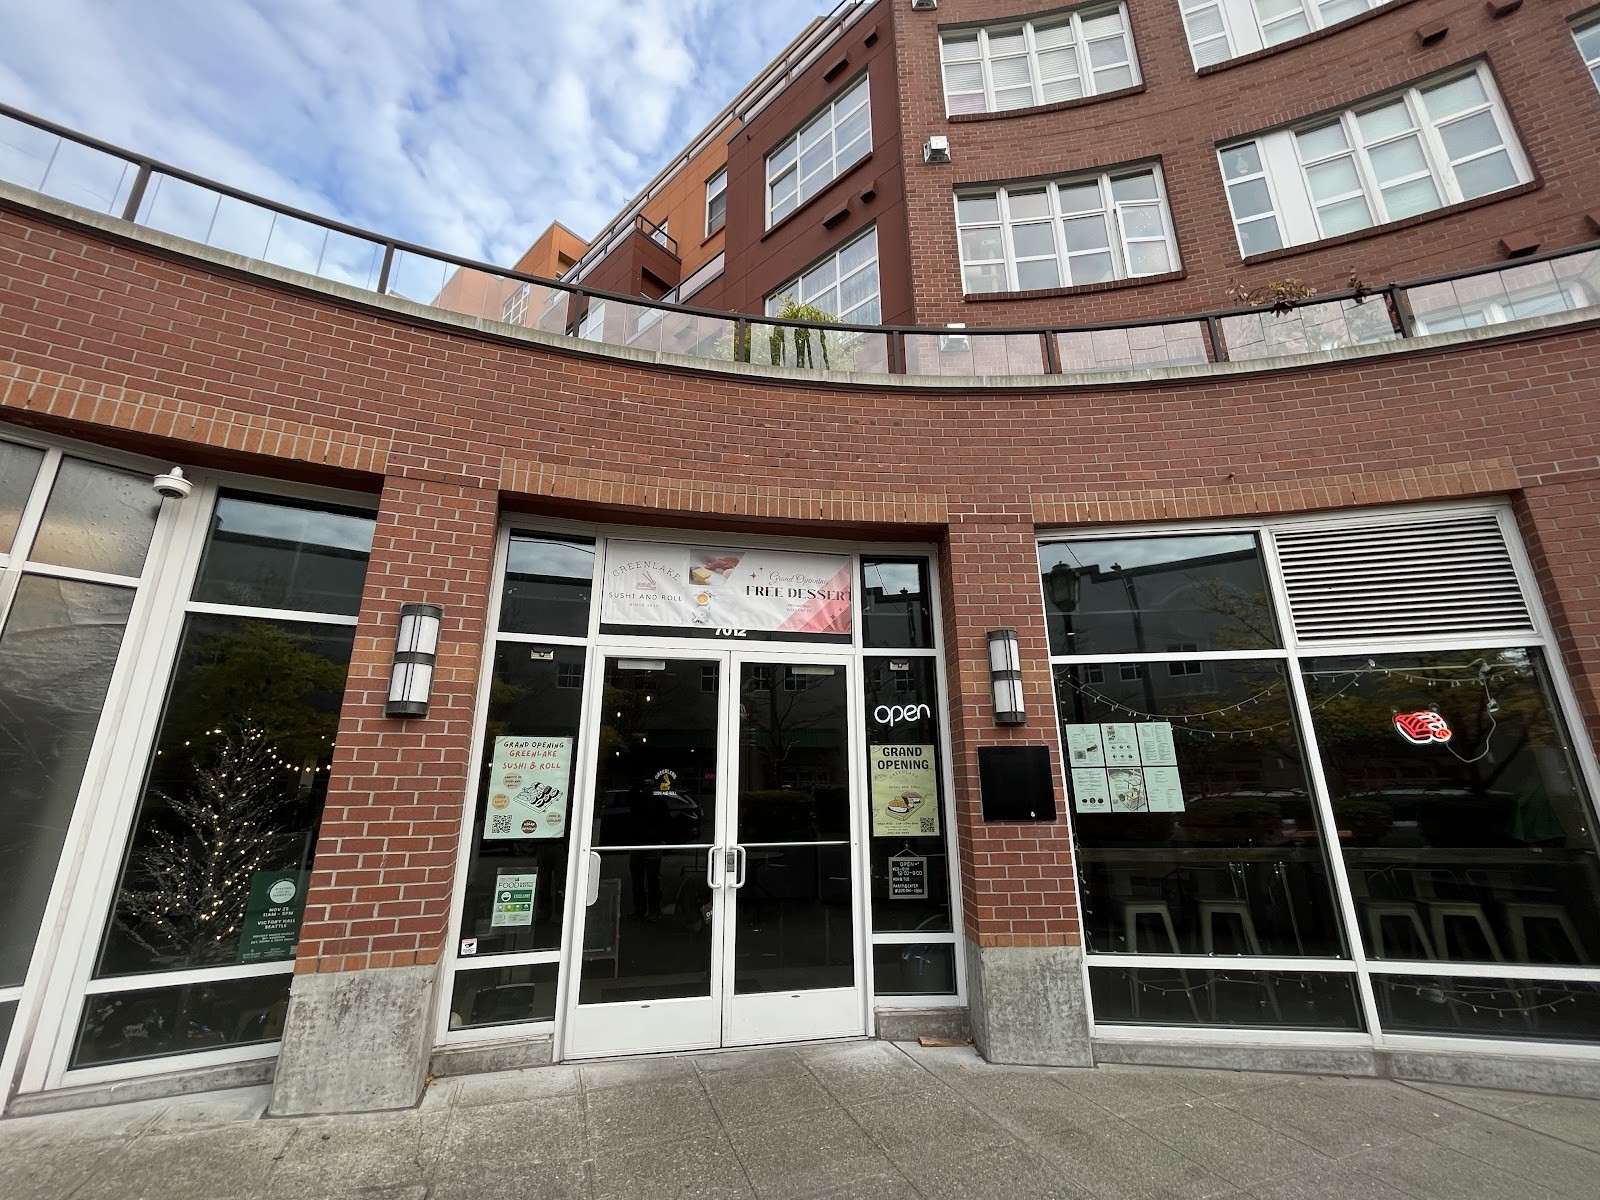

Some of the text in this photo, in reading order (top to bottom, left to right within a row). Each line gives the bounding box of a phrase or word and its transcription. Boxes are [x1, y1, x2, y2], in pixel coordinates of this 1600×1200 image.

[612, 561, 681, 581] GREENLAKE
[768, 571, 829, 590] Grand Opening
[608, 592, 635, 600] SUSHI
[661, 594, 682, 602] ROLL
[746, 585, 784, 598] FREE
[874, 703, 931, 727] open
[503, 741, 564, 749] GRAND OPENING
[509, 749, 557, 758] GREENLAKE
[882, 746, 922, 757] GRAND
[502, 761, 561, 770] SUSHI & ROLL
[877, 759, 929, 770] OPENING
